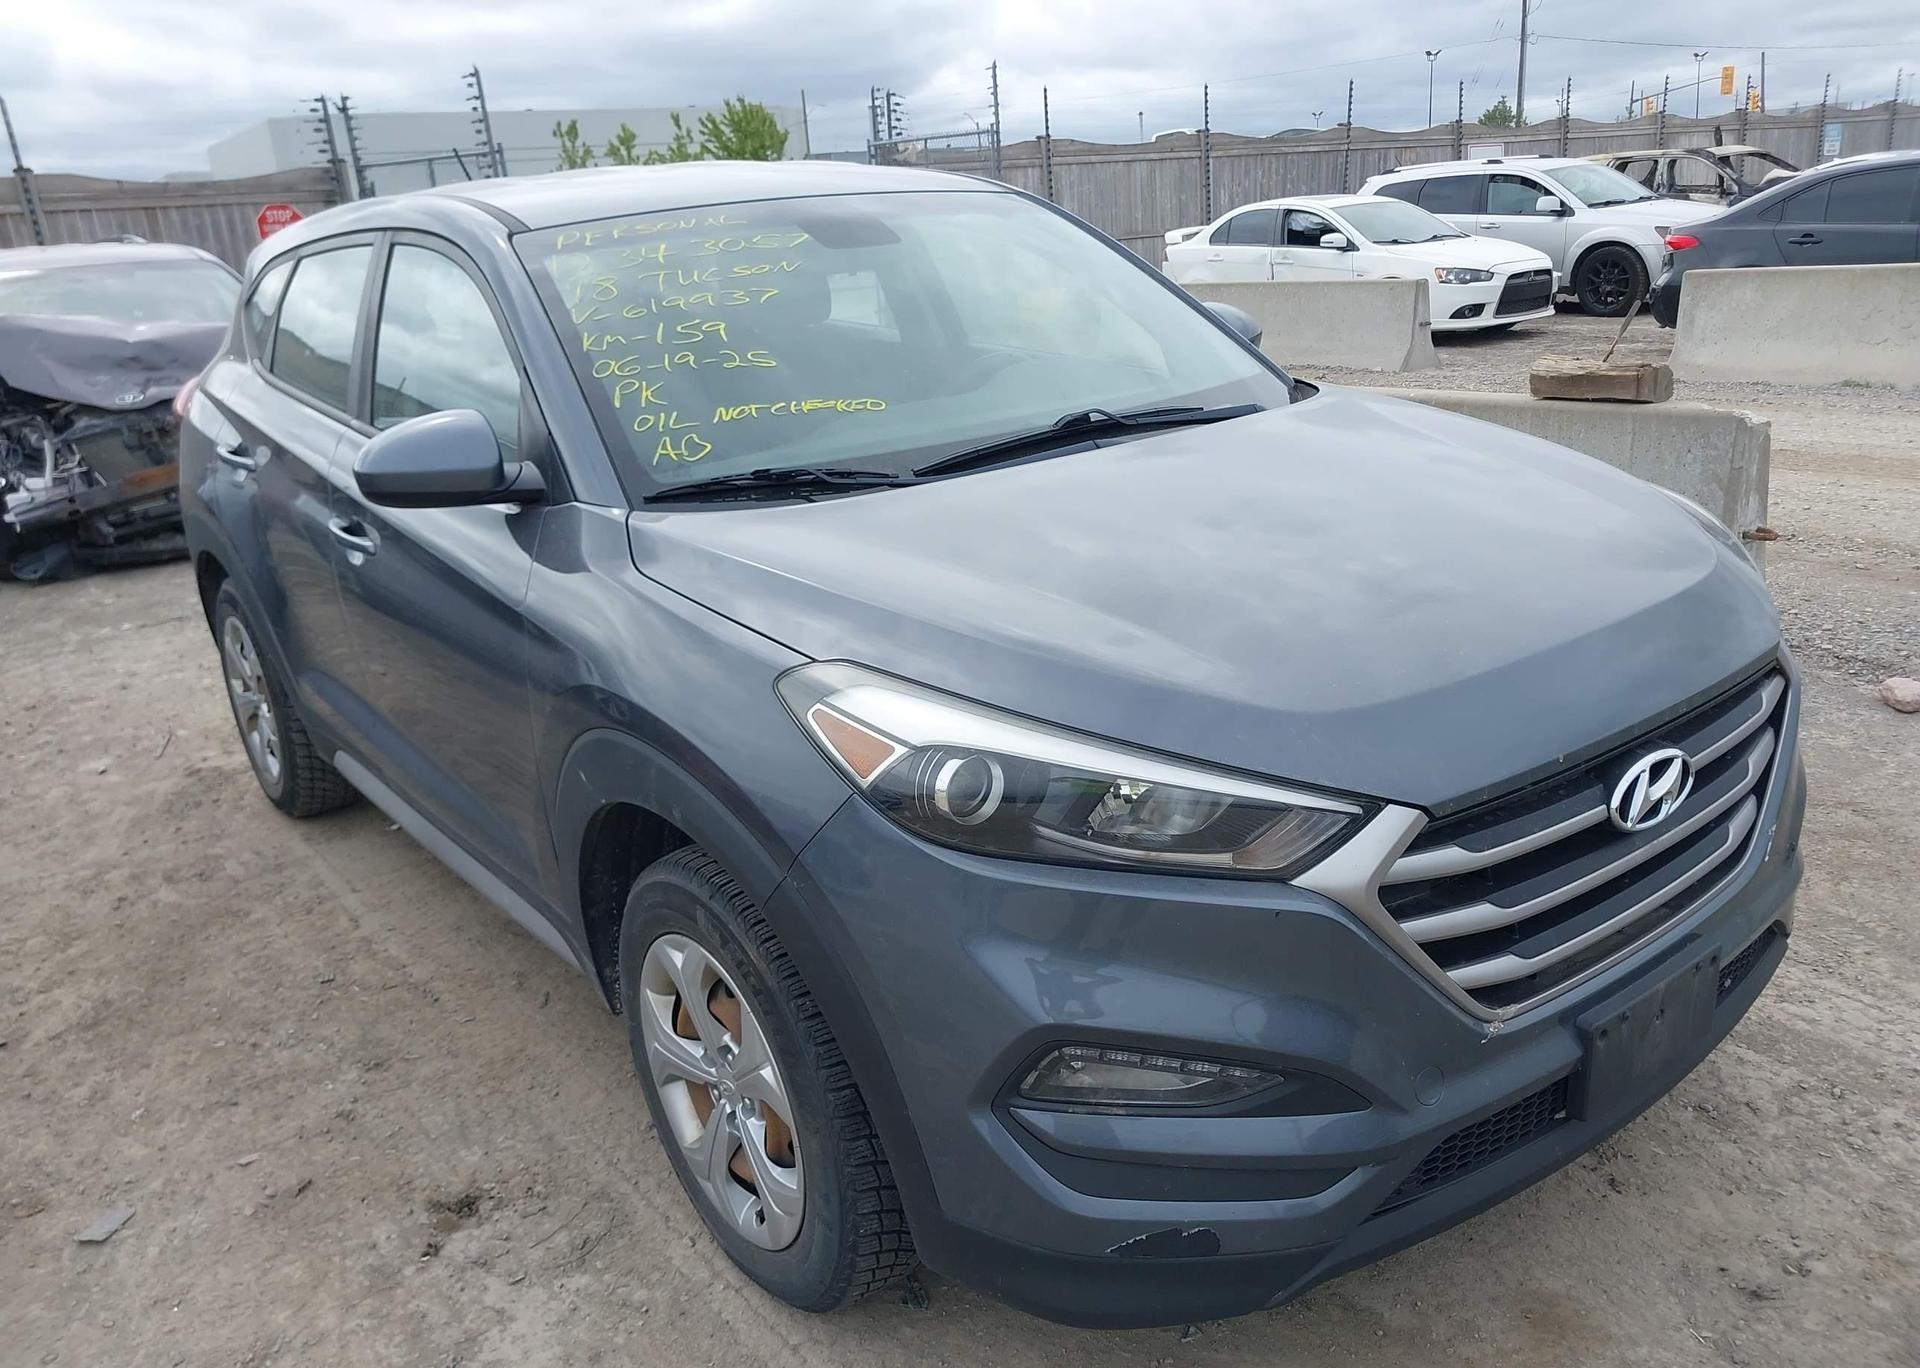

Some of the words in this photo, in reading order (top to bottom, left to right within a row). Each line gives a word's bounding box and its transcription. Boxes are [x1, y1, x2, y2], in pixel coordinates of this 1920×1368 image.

[265, 209, 293, 222] STOP
[638, 261, 802, 293] TUCSON
[592, 350, 777, 378] 06-19-25
[614, 379, 668, 408] PK
[634, 411, 700, 432] OIL
[713, 402, 772, 424] NOT
